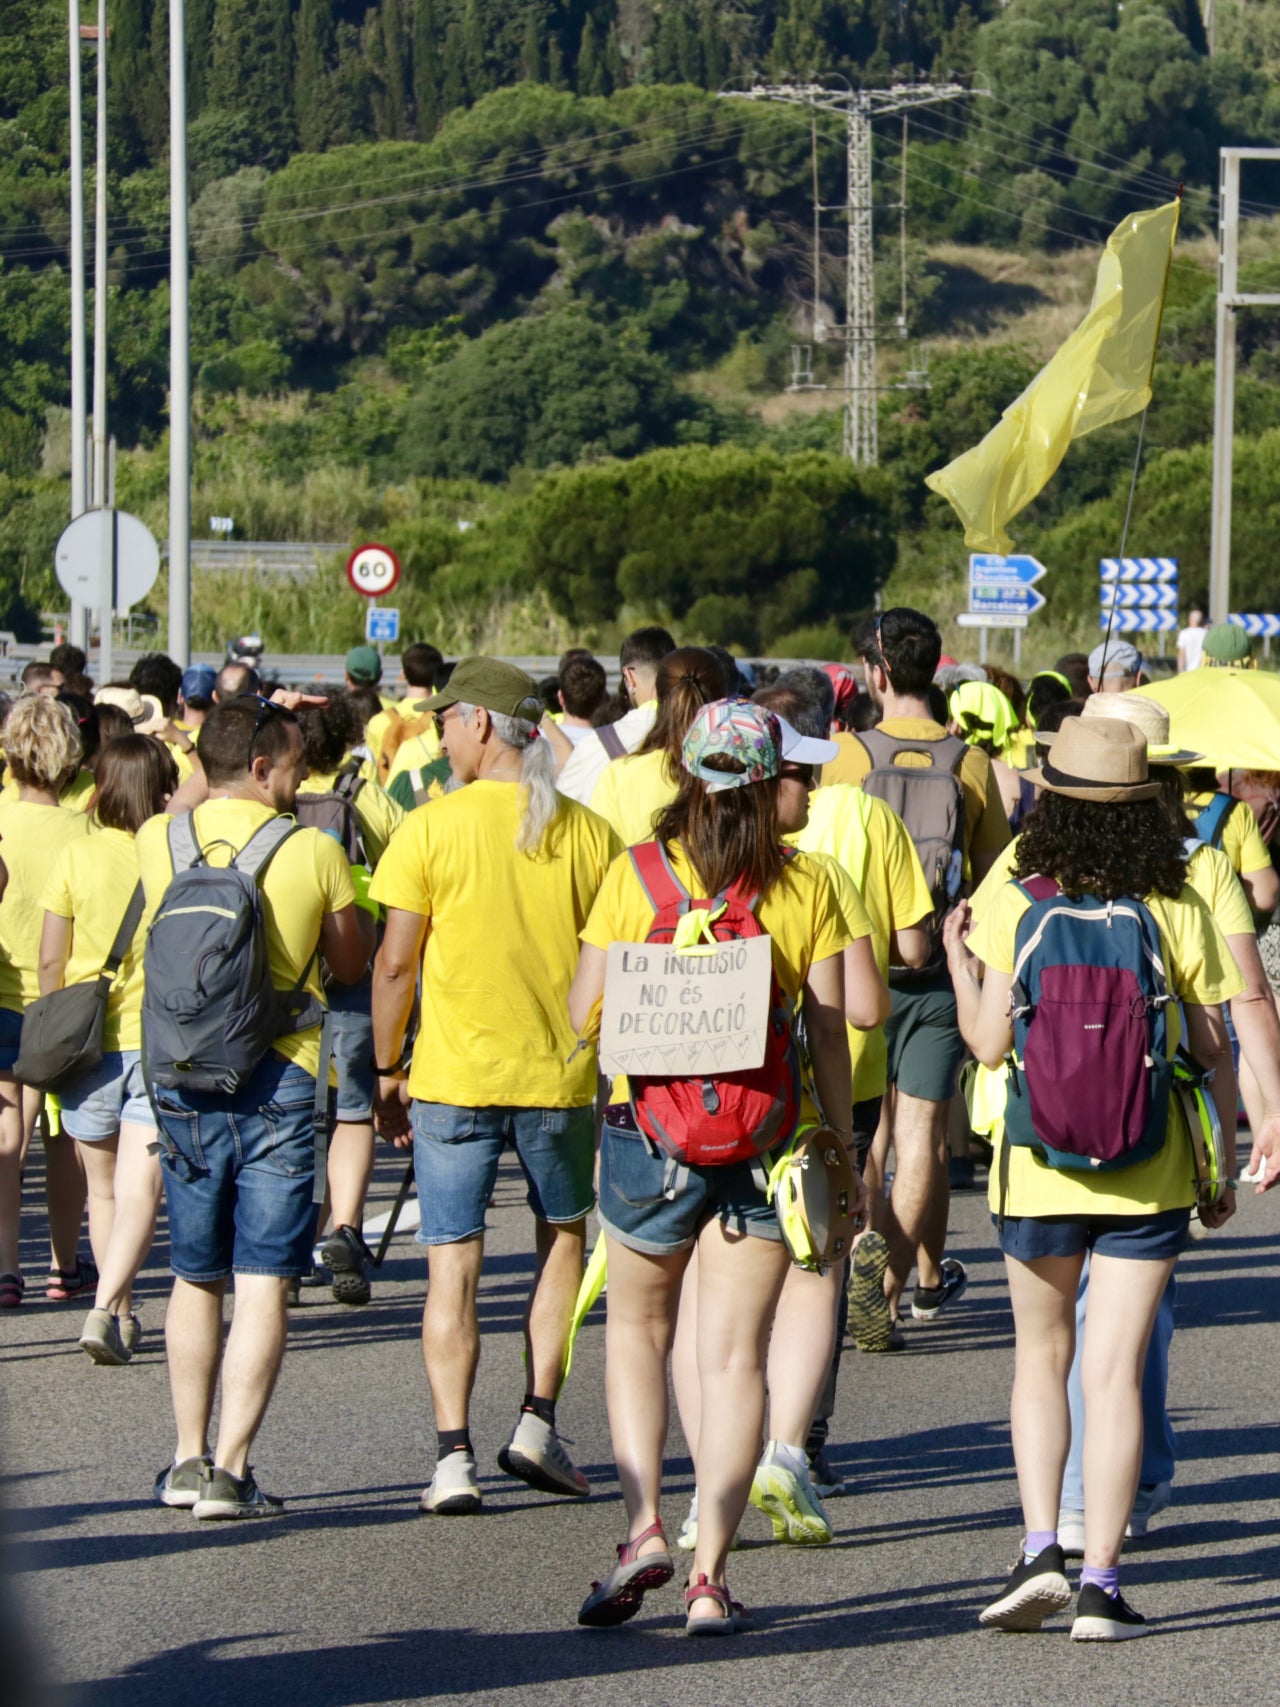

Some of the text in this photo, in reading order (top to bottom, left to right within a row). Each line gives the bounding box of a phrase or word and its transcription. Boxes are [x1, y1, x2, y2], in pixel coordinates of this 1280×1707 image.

[359, 562, 387, 578] 60
[621, 951, 649, 973] La
[639, 979, 703, 1008] NO és
